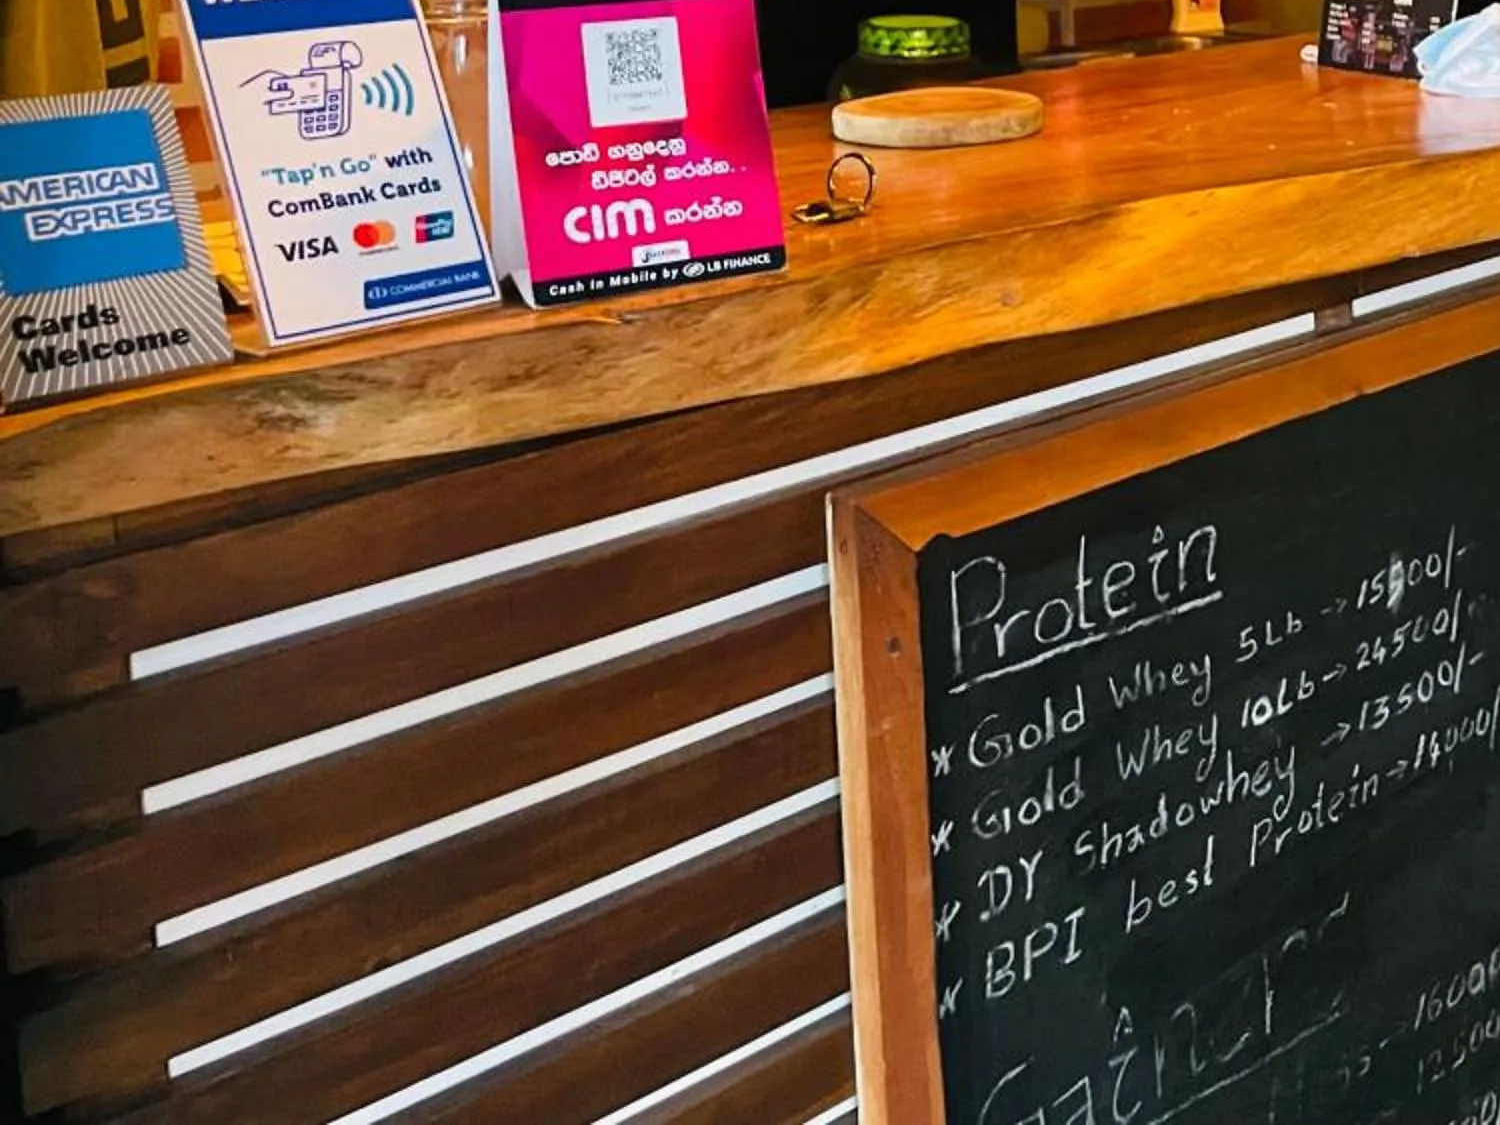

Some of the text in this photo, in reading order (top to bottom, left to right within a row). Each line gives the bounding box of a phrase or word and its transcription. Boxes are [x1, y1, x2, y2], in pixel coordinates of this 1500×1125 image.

[384, 147, 433, 170] with
[29, 195, 175, 239] EXPRESS
[267, 176, 442, 218] ComBank Cards
[276, 235, 340, 263] VISA
[548, 279, 586, 297] Cash
[608, 267, 658, 290] Mobile
[661, 263, 680, 282] by
[706, 261, 722, 274] LB
[723, 252, 772, 271] FINANCE
[11, 304, 120, 341] Cards
[18, 327, 191, 375] Welcome
[950, 524, 1218, 676] Protein
[967, 684, 1086, 769] Gold
[1108, 653, 1213, 709] Whey
[971, 755, 1086, 839] Gold
[1116, 711, 1218, 783] Whey
[985, 906, 1086, 999] BPI
